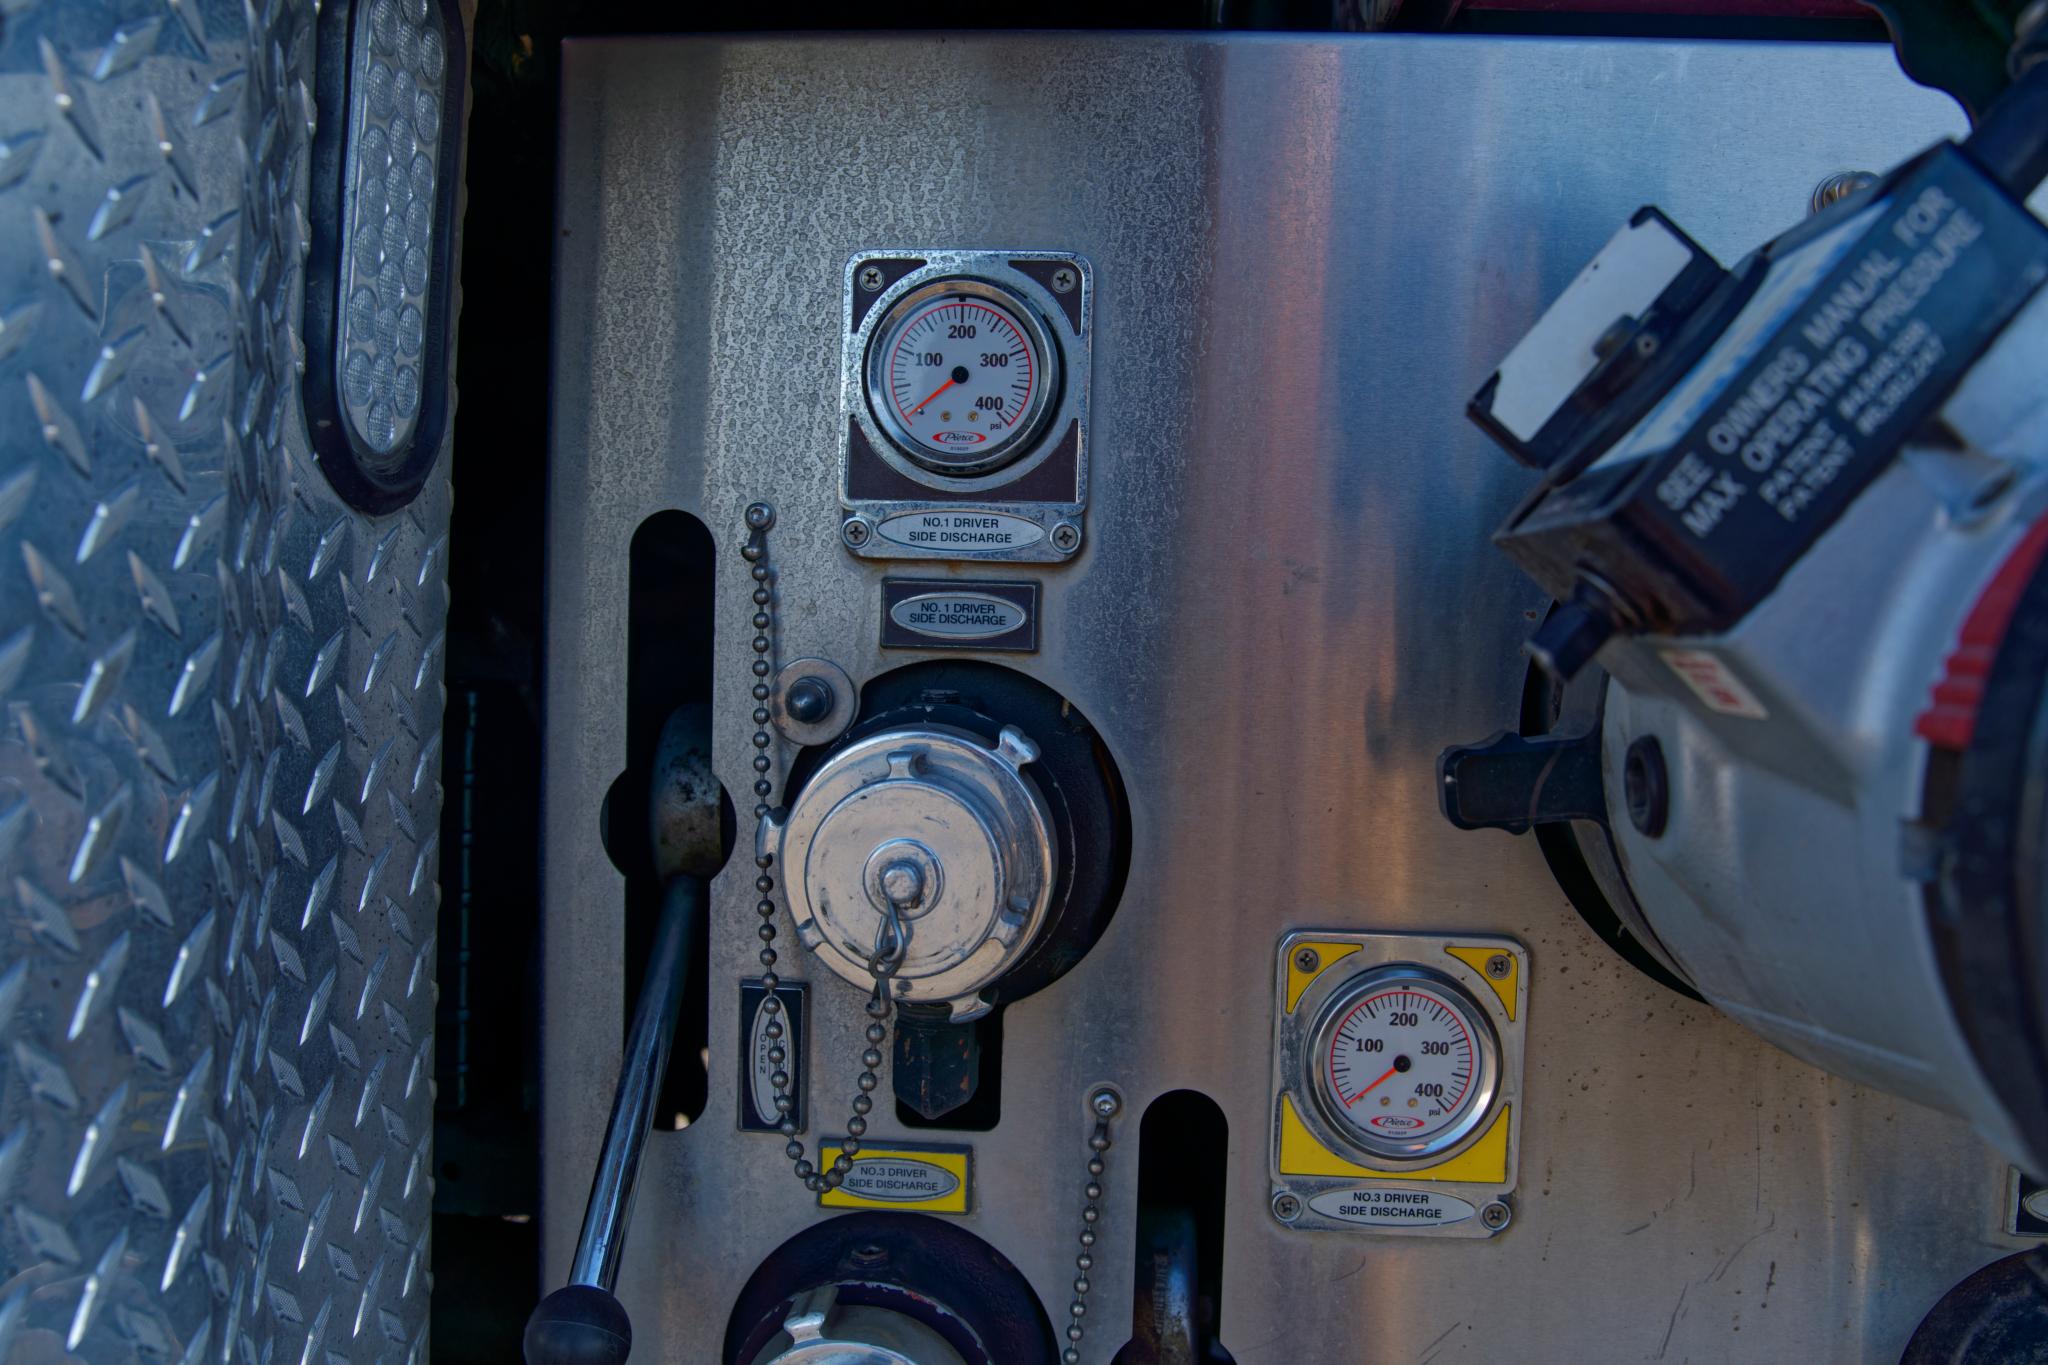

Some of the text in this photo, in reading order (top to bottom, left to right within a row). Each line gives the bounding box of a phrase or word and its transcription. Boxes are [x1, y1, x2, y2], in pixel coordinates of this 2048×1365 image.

[948, 325, 976, 339] 200
[1657, 453, 1713, 510] SEE
[1707, 346, 1808, 456] OWNERS
[1802, 249, 1900, 349] MANUAL
[1893, 186, 1954, 247] FOR
[915, 352, 943, 367] 100
[980, 353, 1008, 367] 300
[1681, 470, 1746, 538] MAX
[1741, 335, 1867, 472] OPERATING
[1860, 209, 1983, 339] PRESSURE
[975, 396, 1004, 411] 400
[990, 421, 1002, 431] psi
[923, 517, 999, 529] NO.1 DRIVER
[909, 532, 1012, 543] SIDE DISCHARGE
[954, 604, 995, 614] DRIVER
[909, 613, 1006, 625] SIDE DISCHARGE
[1389, 1012, 1418, 1027] 200
[1356, 1038, 1383, 1053] 100
[1421, 1041, 1449, 1055] 300
[759, 1033, 767, 1074] OPEN
[1414, 1083, 1443, 1097] 400
[1429, 1107, 1440, 1116] psi
[860, 1166, 927, 1178] NO.3 DRIVER
[848, 1178, 938, 1191] SIDE DISCHARGE
[1354, 1192, 1429, 1205] NO.3 DRIVER
[1339, 1206, 1442, 1219] SIDE DISCHARGE
